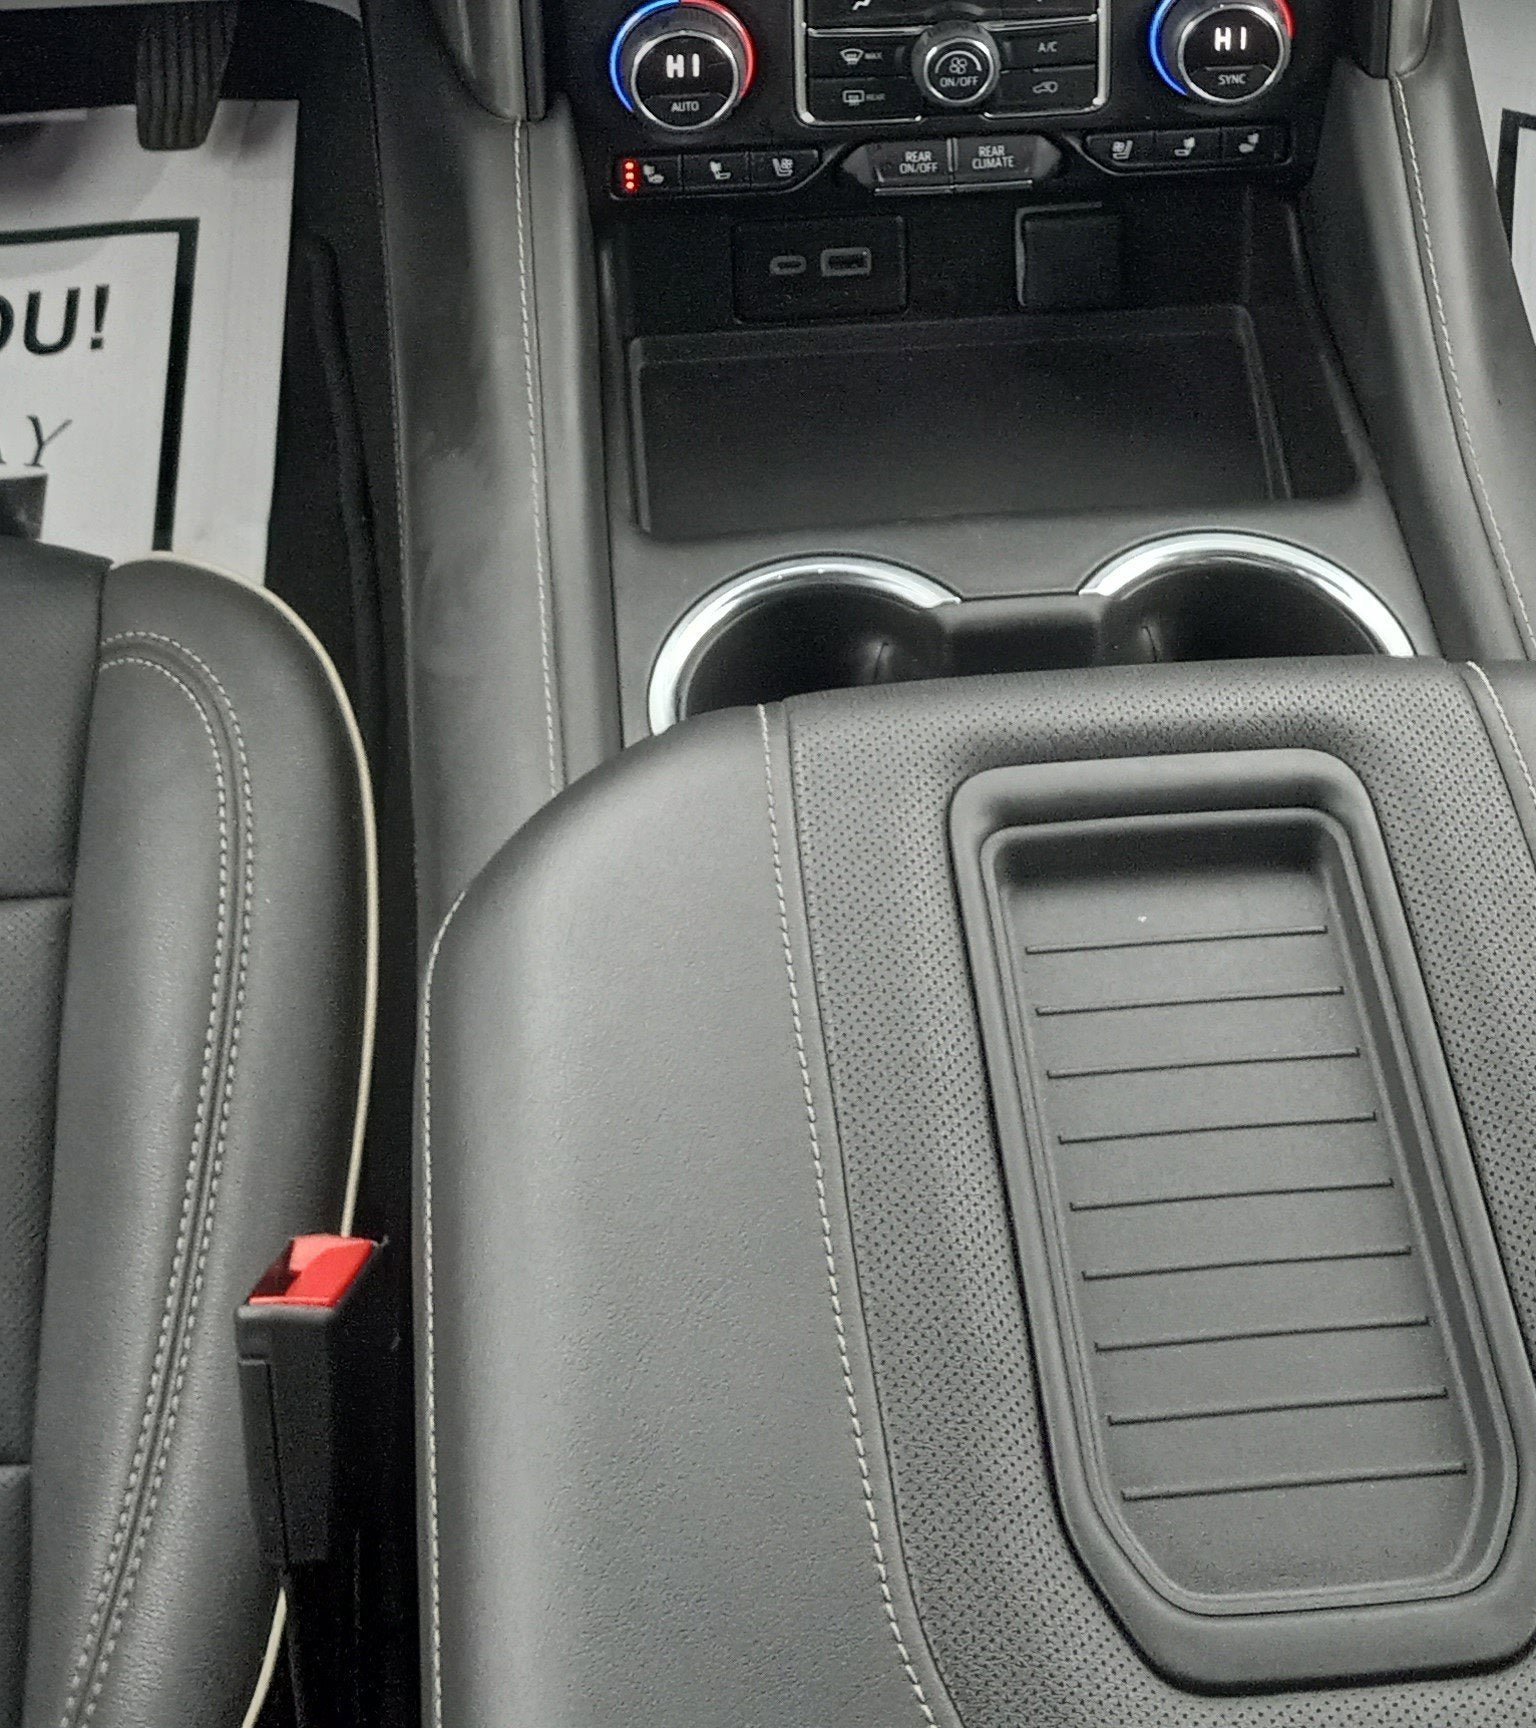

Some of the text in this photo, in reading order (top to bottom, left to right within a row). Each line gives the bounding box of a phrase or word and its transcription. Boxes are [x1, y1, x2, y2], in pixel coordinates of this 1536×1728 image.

[1214, 26, 1247, 52] HI
[1037, 41, 1058, 53] A/C
[666, 53, 700, 79] HI
[939, 76, 980, 88] ON/OFF
[1217, 73, 1247, 85] SYNC
[671, 100, 700, 112] AUTO
[905, 151, 932, 162] REAR
[978, 145, 1005, 157] REAR
[899, 162, 938, 174] ON/OFF
[972, 156, 1015, 170] CLIMATE
